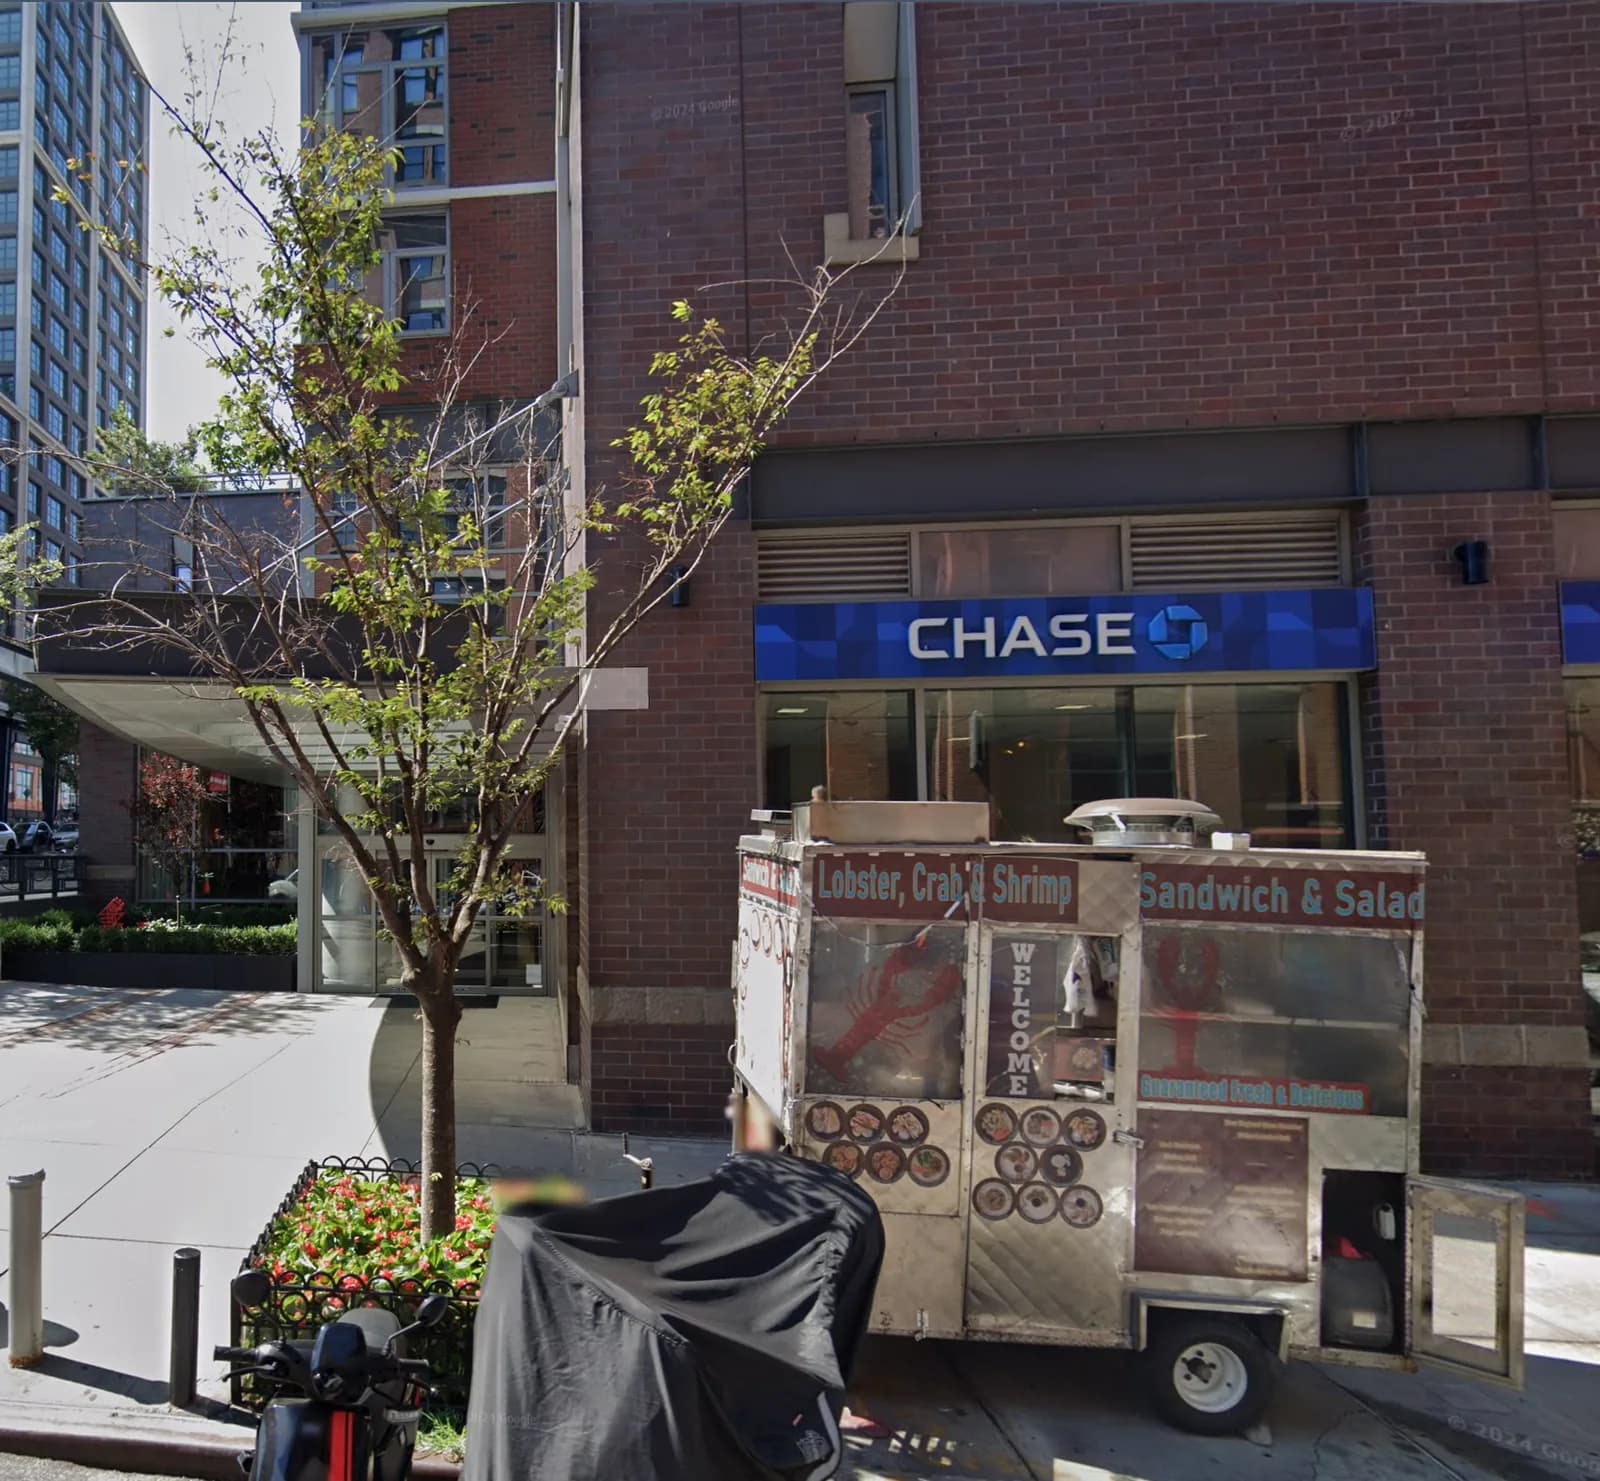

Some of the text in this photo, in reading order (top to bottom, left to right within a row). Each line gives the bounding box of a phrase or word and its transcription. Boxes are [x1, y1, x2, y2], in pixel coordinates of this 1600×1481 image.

[908, 613, 1136, 660] CHASE
[818, 861, 904, 908] Lobster,
[912, 862, 965, 903] Crab
[971, 864, 985, 902] &
[993, 864, 1072, 914] Shrimp
[1140, 872, 1424, 919] Sandwich & Salad
[1009, 943, 1036, 1096] WELCOME
[1230, 1079, 1272, 1105] Fresh
[1289, 1083, 1364, 1109] Delicious
